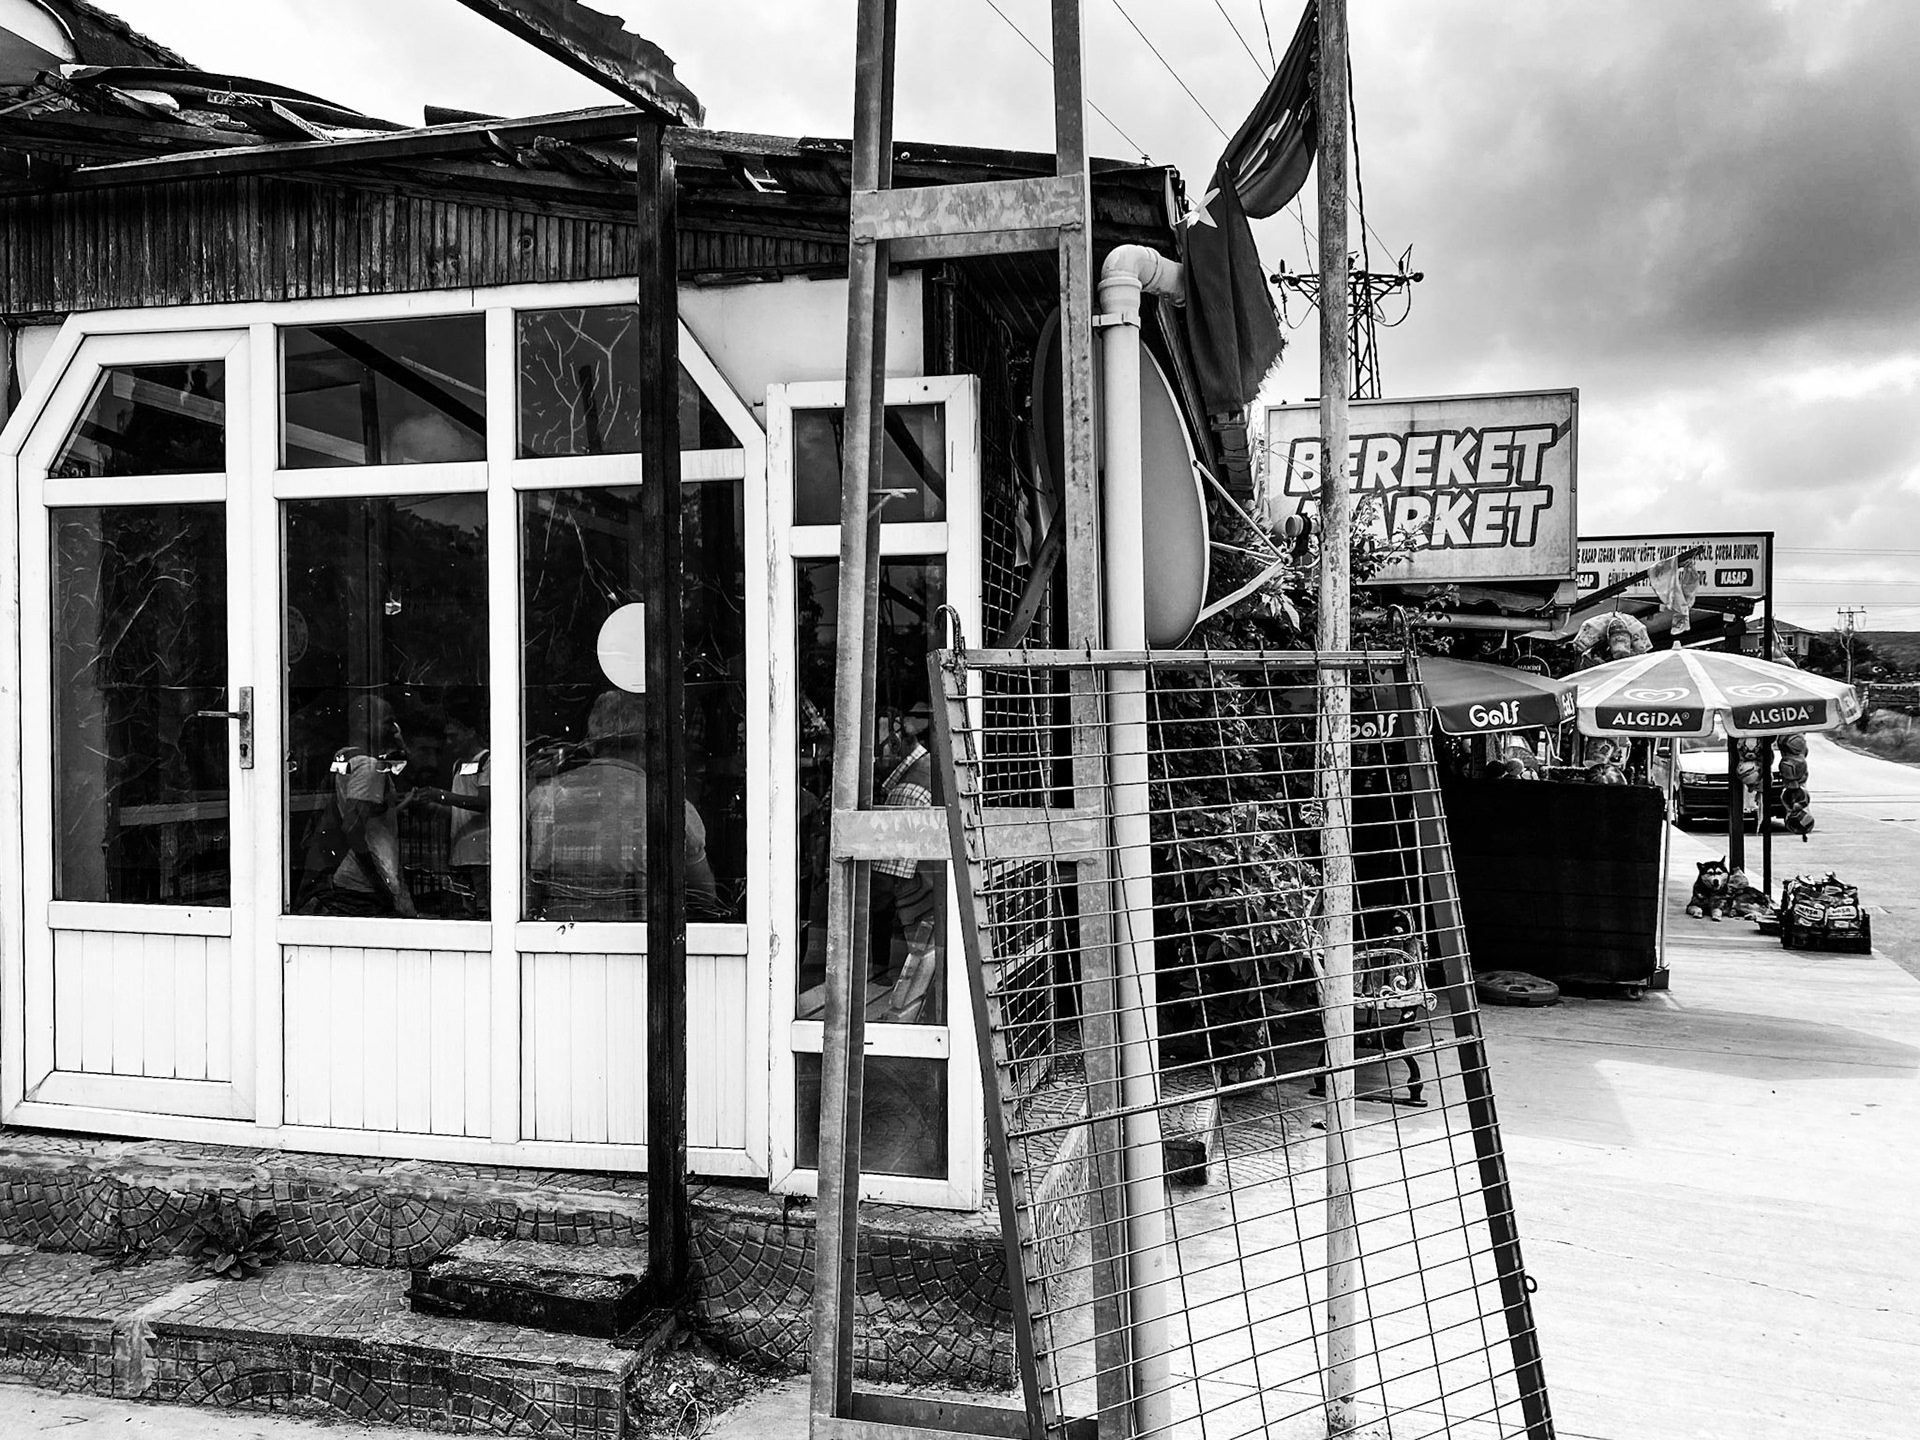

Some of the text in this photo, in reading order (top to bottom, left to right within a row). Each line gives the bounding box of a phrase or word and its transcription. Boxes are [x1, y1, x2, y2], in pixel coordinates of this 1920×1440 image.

[1297, 486, 1553, 551] ARKET
[1578, 573, 1594, 587] SAP
[1721, 571, 1747, 585] KASAP
[1469, 700, 1520, 727] Golf
